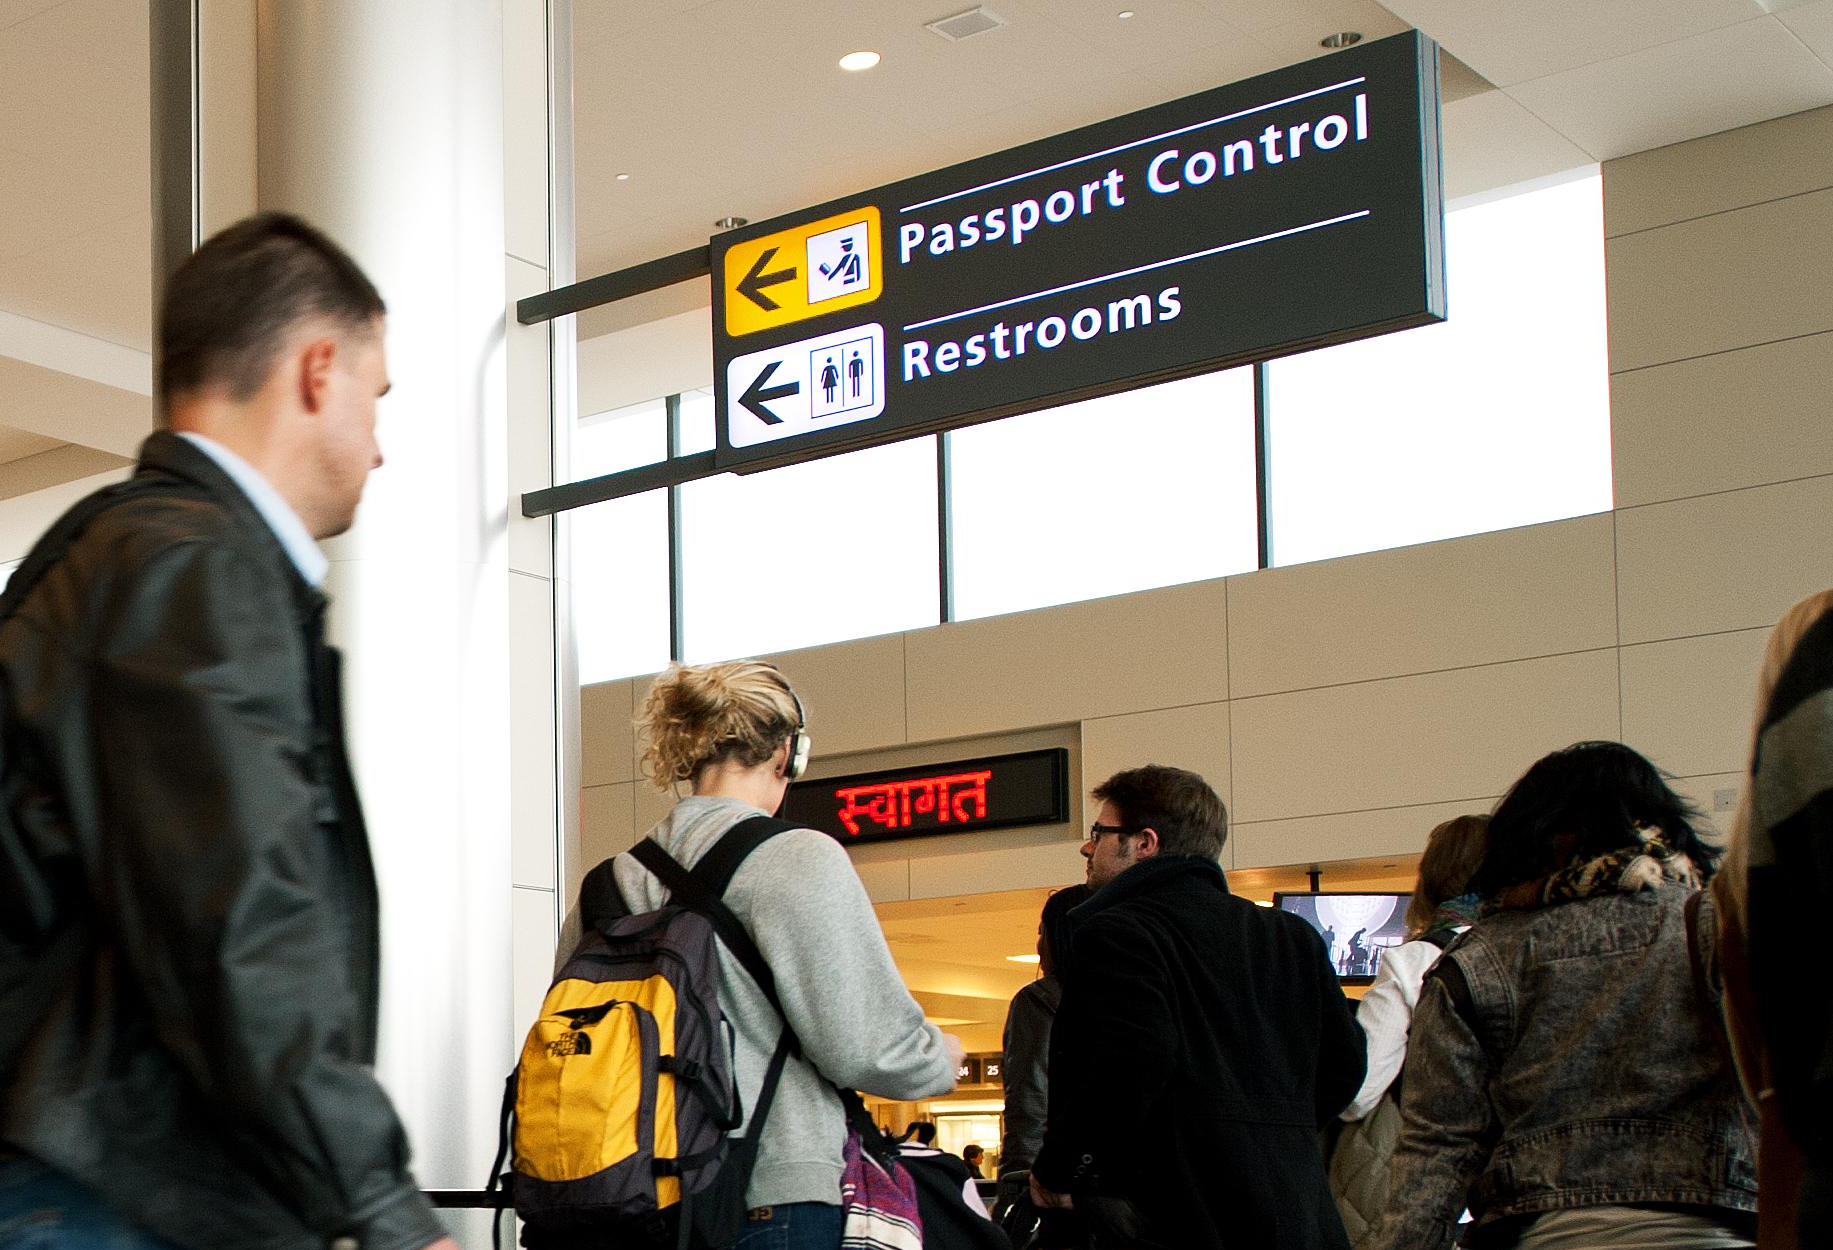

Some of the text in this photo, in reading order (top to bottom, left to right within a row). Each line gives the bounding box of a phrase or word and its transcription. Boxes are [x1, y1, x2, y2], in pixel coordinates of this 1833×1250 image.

[899, 93, 1368, 264] Passport Control
[903, 286, 1181, 382] Restrooms
[836, 770, 991, 835] स्वागत
[987, 1065, 999, 1076] 25
